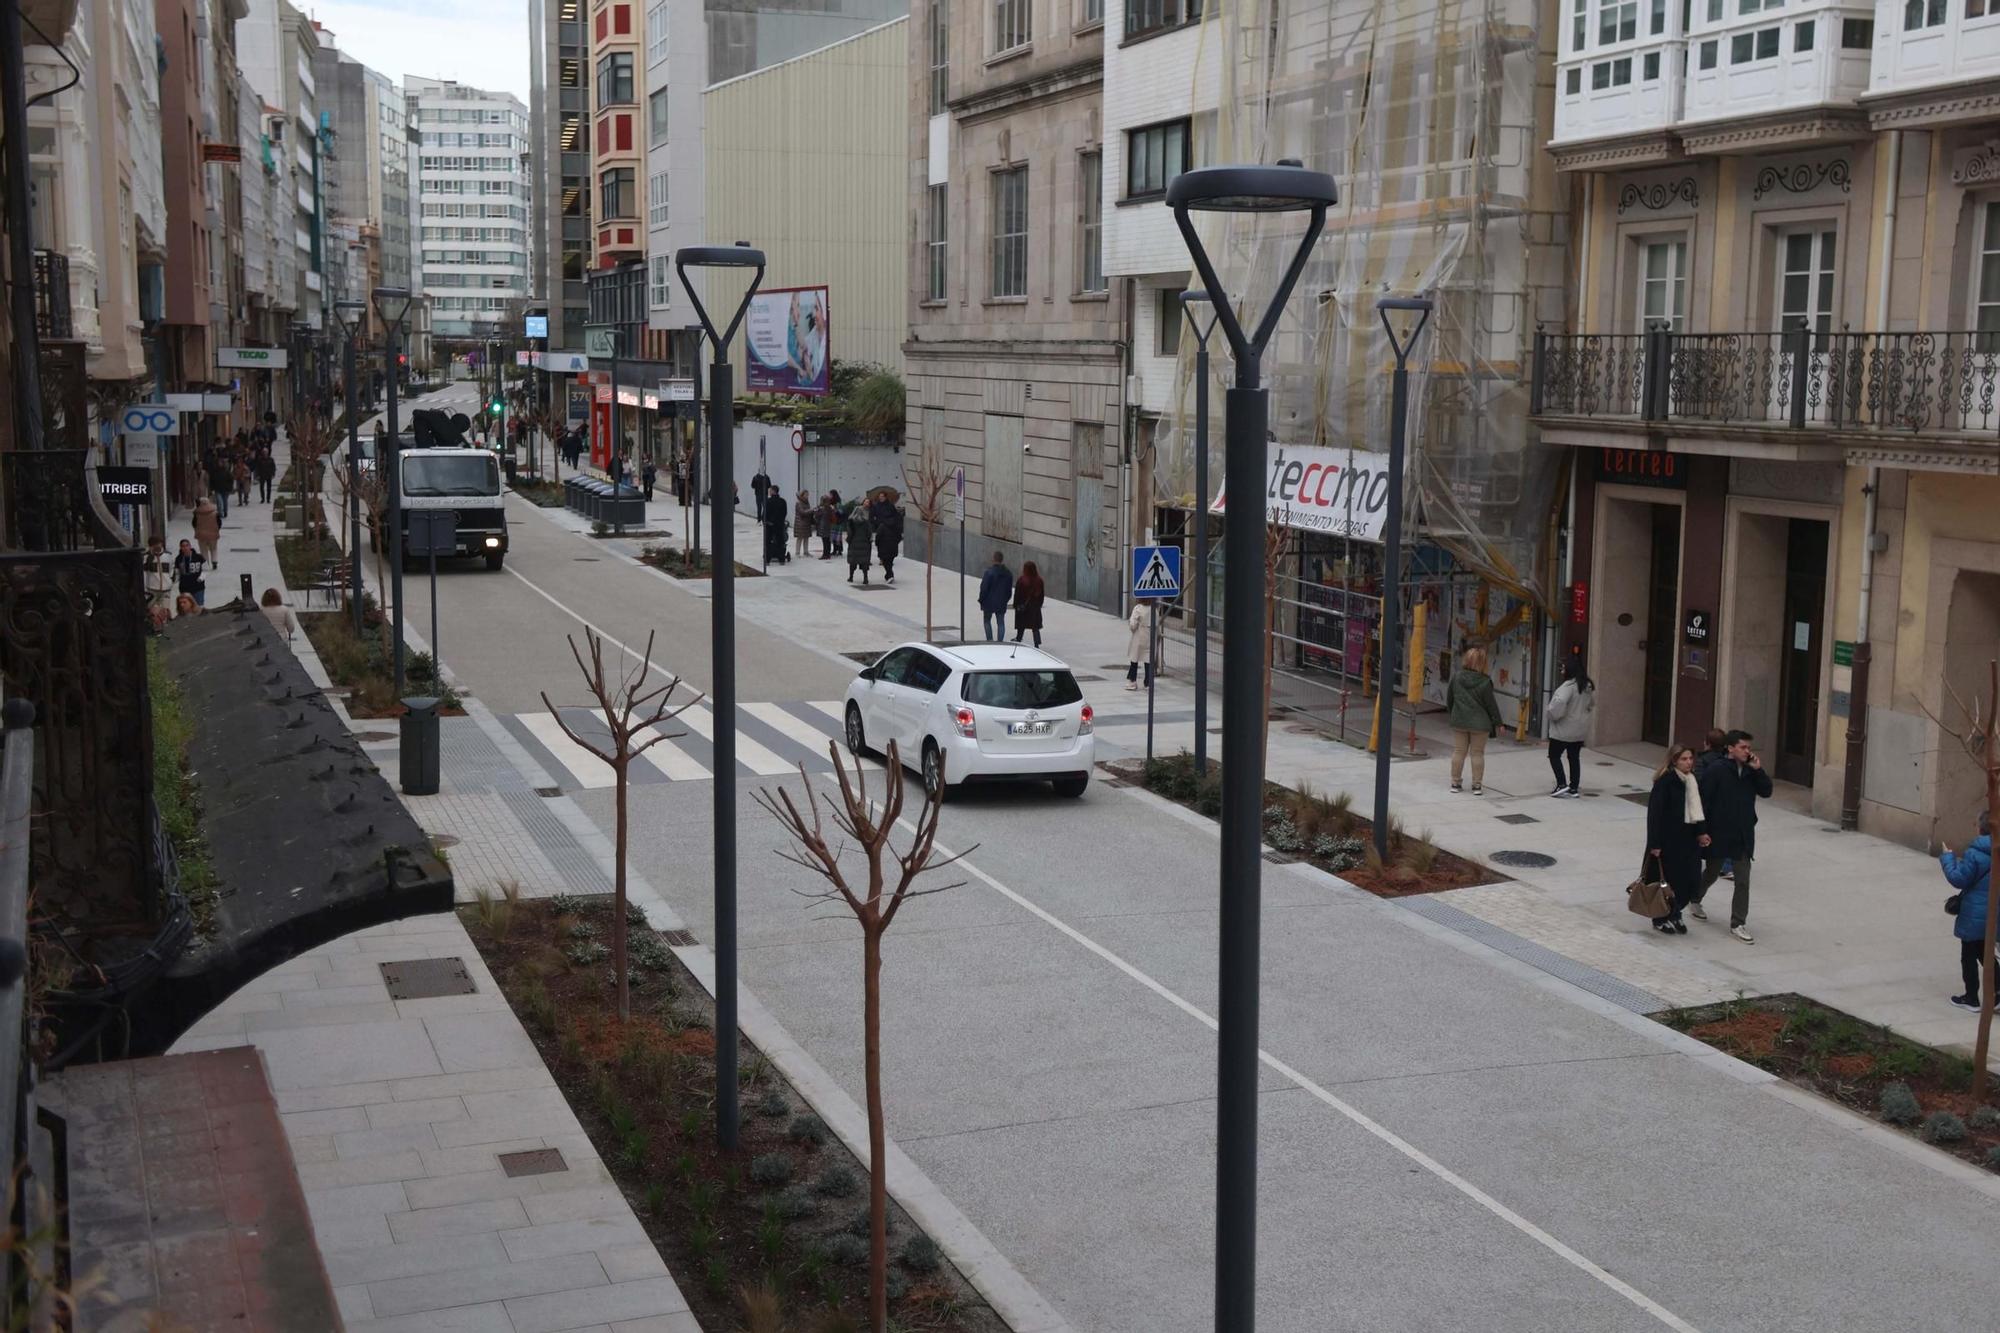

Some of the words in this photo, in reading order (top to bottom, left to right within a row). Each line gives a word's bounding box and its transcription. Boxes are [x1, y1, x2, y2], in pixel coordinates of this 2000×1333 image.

[1603, 447, 1675, 476] terreo
[98, 483, 147, 494] ITRIBER
[1013, 724, 1034, 734] 4625
